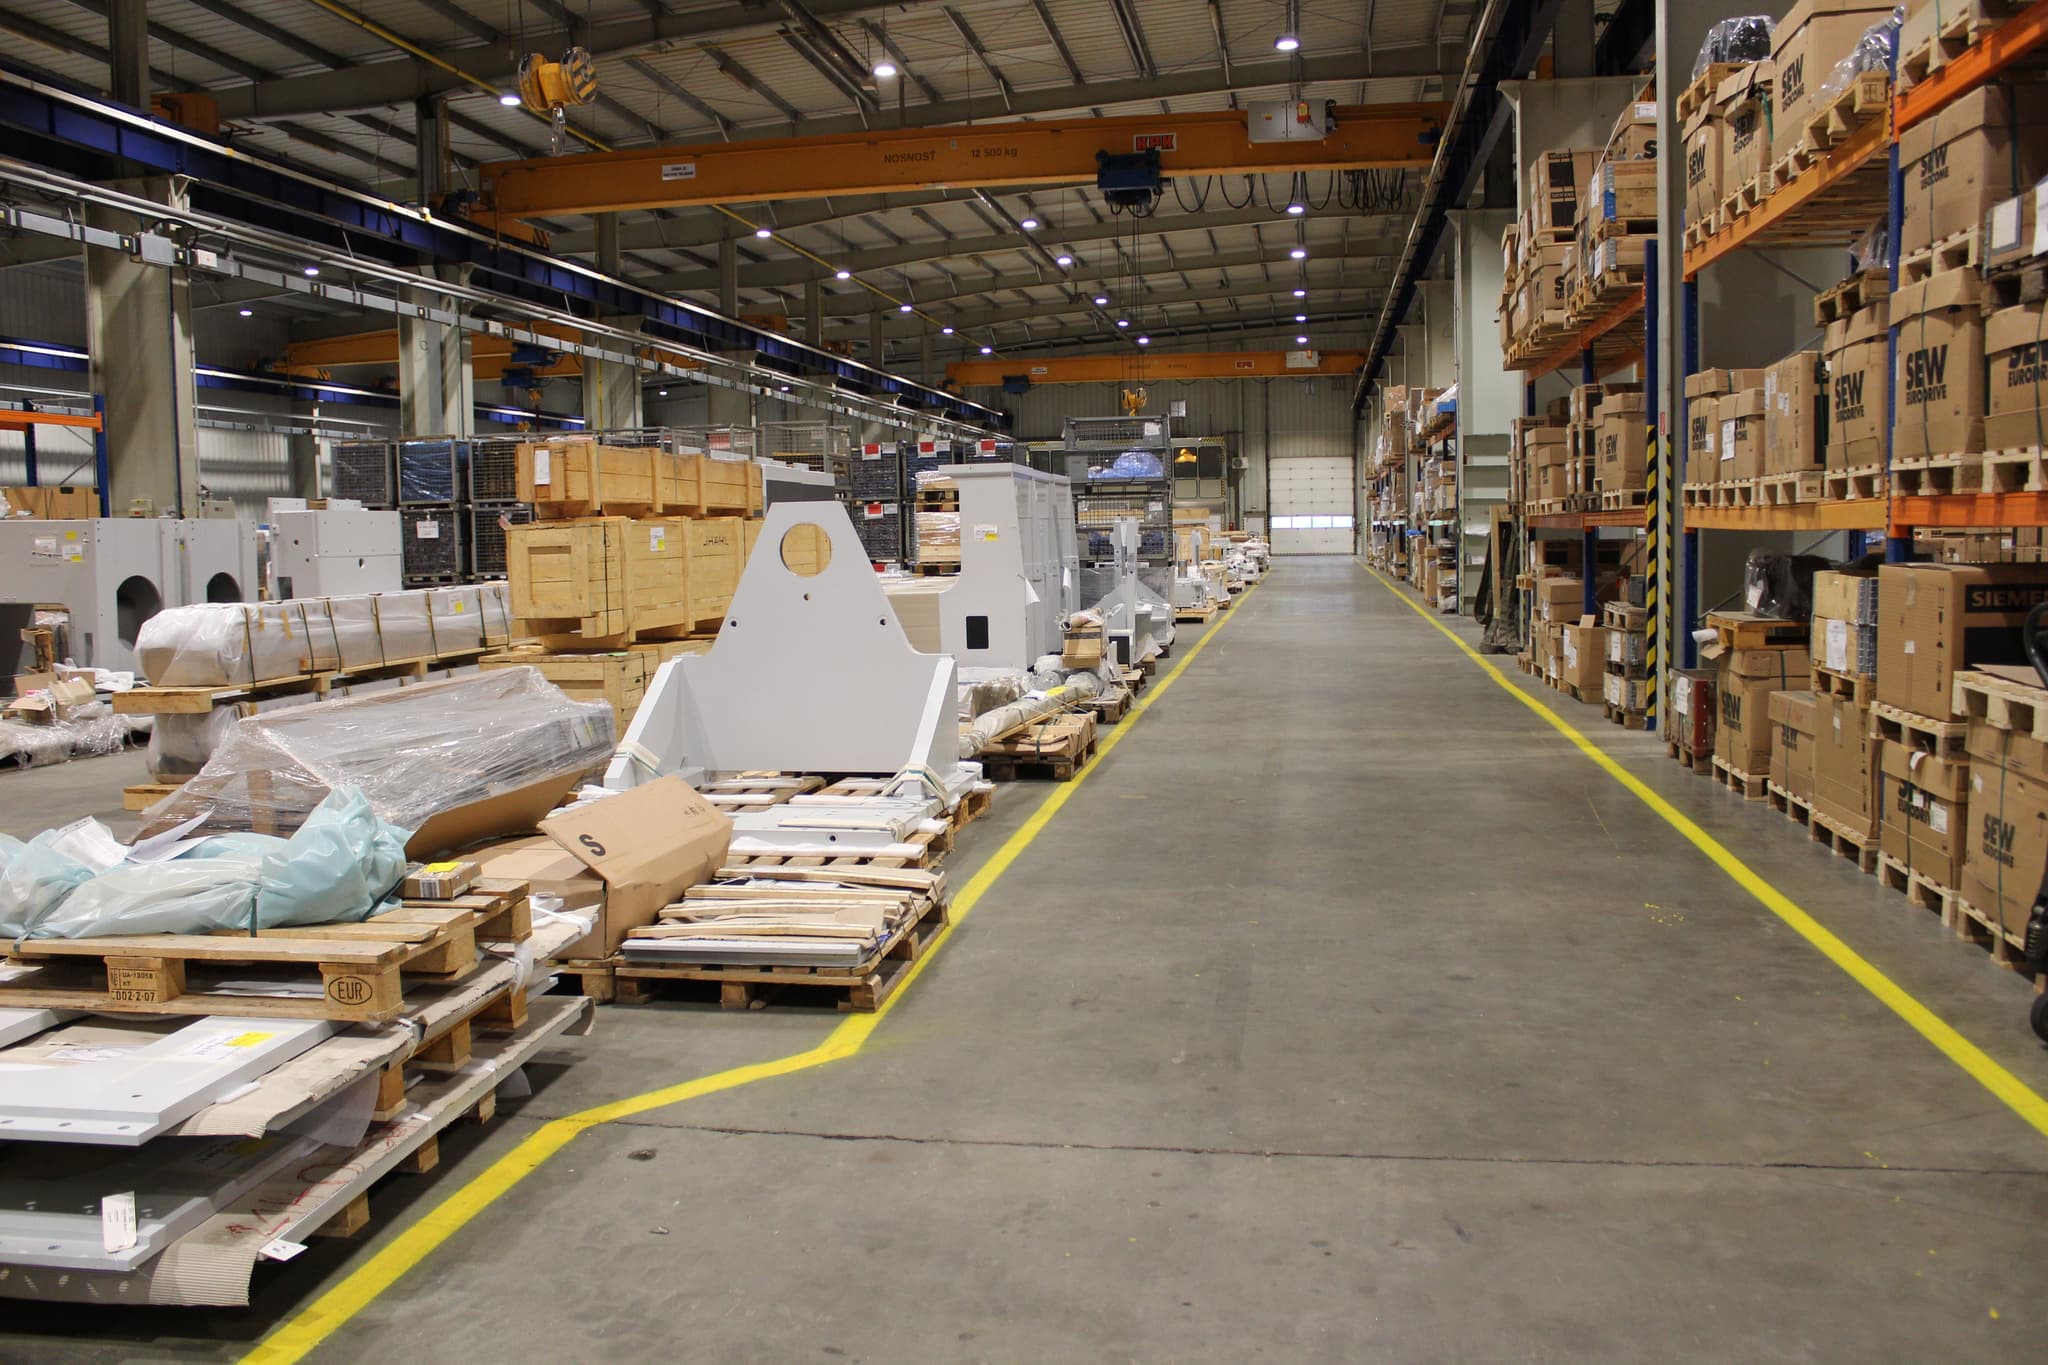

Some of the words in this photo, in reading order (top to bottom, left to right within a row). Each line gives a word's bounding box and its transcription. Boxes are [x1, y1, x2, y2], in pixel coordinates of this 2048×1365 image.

[1782, 53, 1804, 99] SEW
[1689, 144, 1706, 180] SEW
[1906, 344, 1948, 390] SEW
[2008, 363, 2048, 388] EURODR
[1835, 370, 1864, 410] SEW
[1906, 384, 1947, 406] EURODRIVE
[1983, 813, 2015, 852] SEW
[338, 981, 362, 1000] EUR
